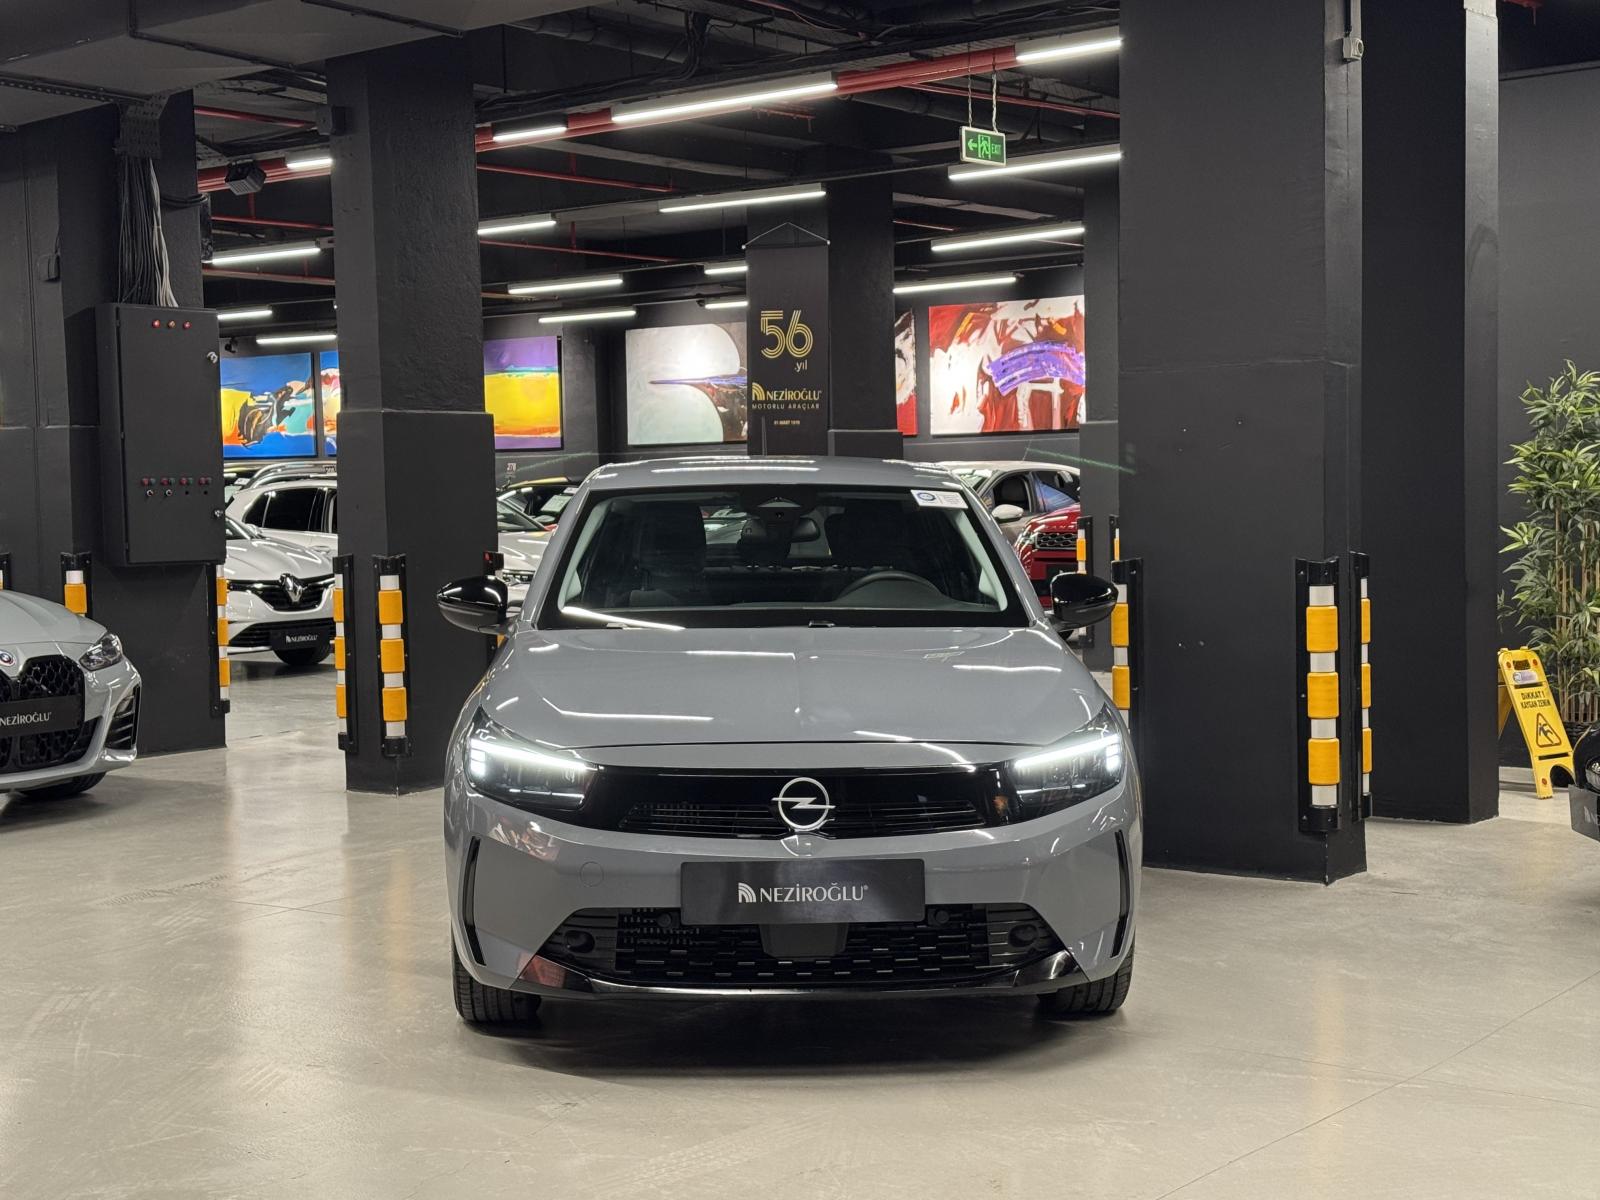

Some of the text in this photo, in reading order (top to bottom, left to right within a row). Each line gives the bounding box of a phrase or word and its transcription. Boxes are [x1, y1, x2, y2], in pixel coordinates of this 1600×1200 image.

[991, 143, 1002, 154] EXIT
[760, 309, 814, 359] 56
[766, 387, 820, 401] NEZİROĞLU
[788, 403, 820, 411] ARAÇLAR
[760, 883, 864, 903] NEZİROĞLU
